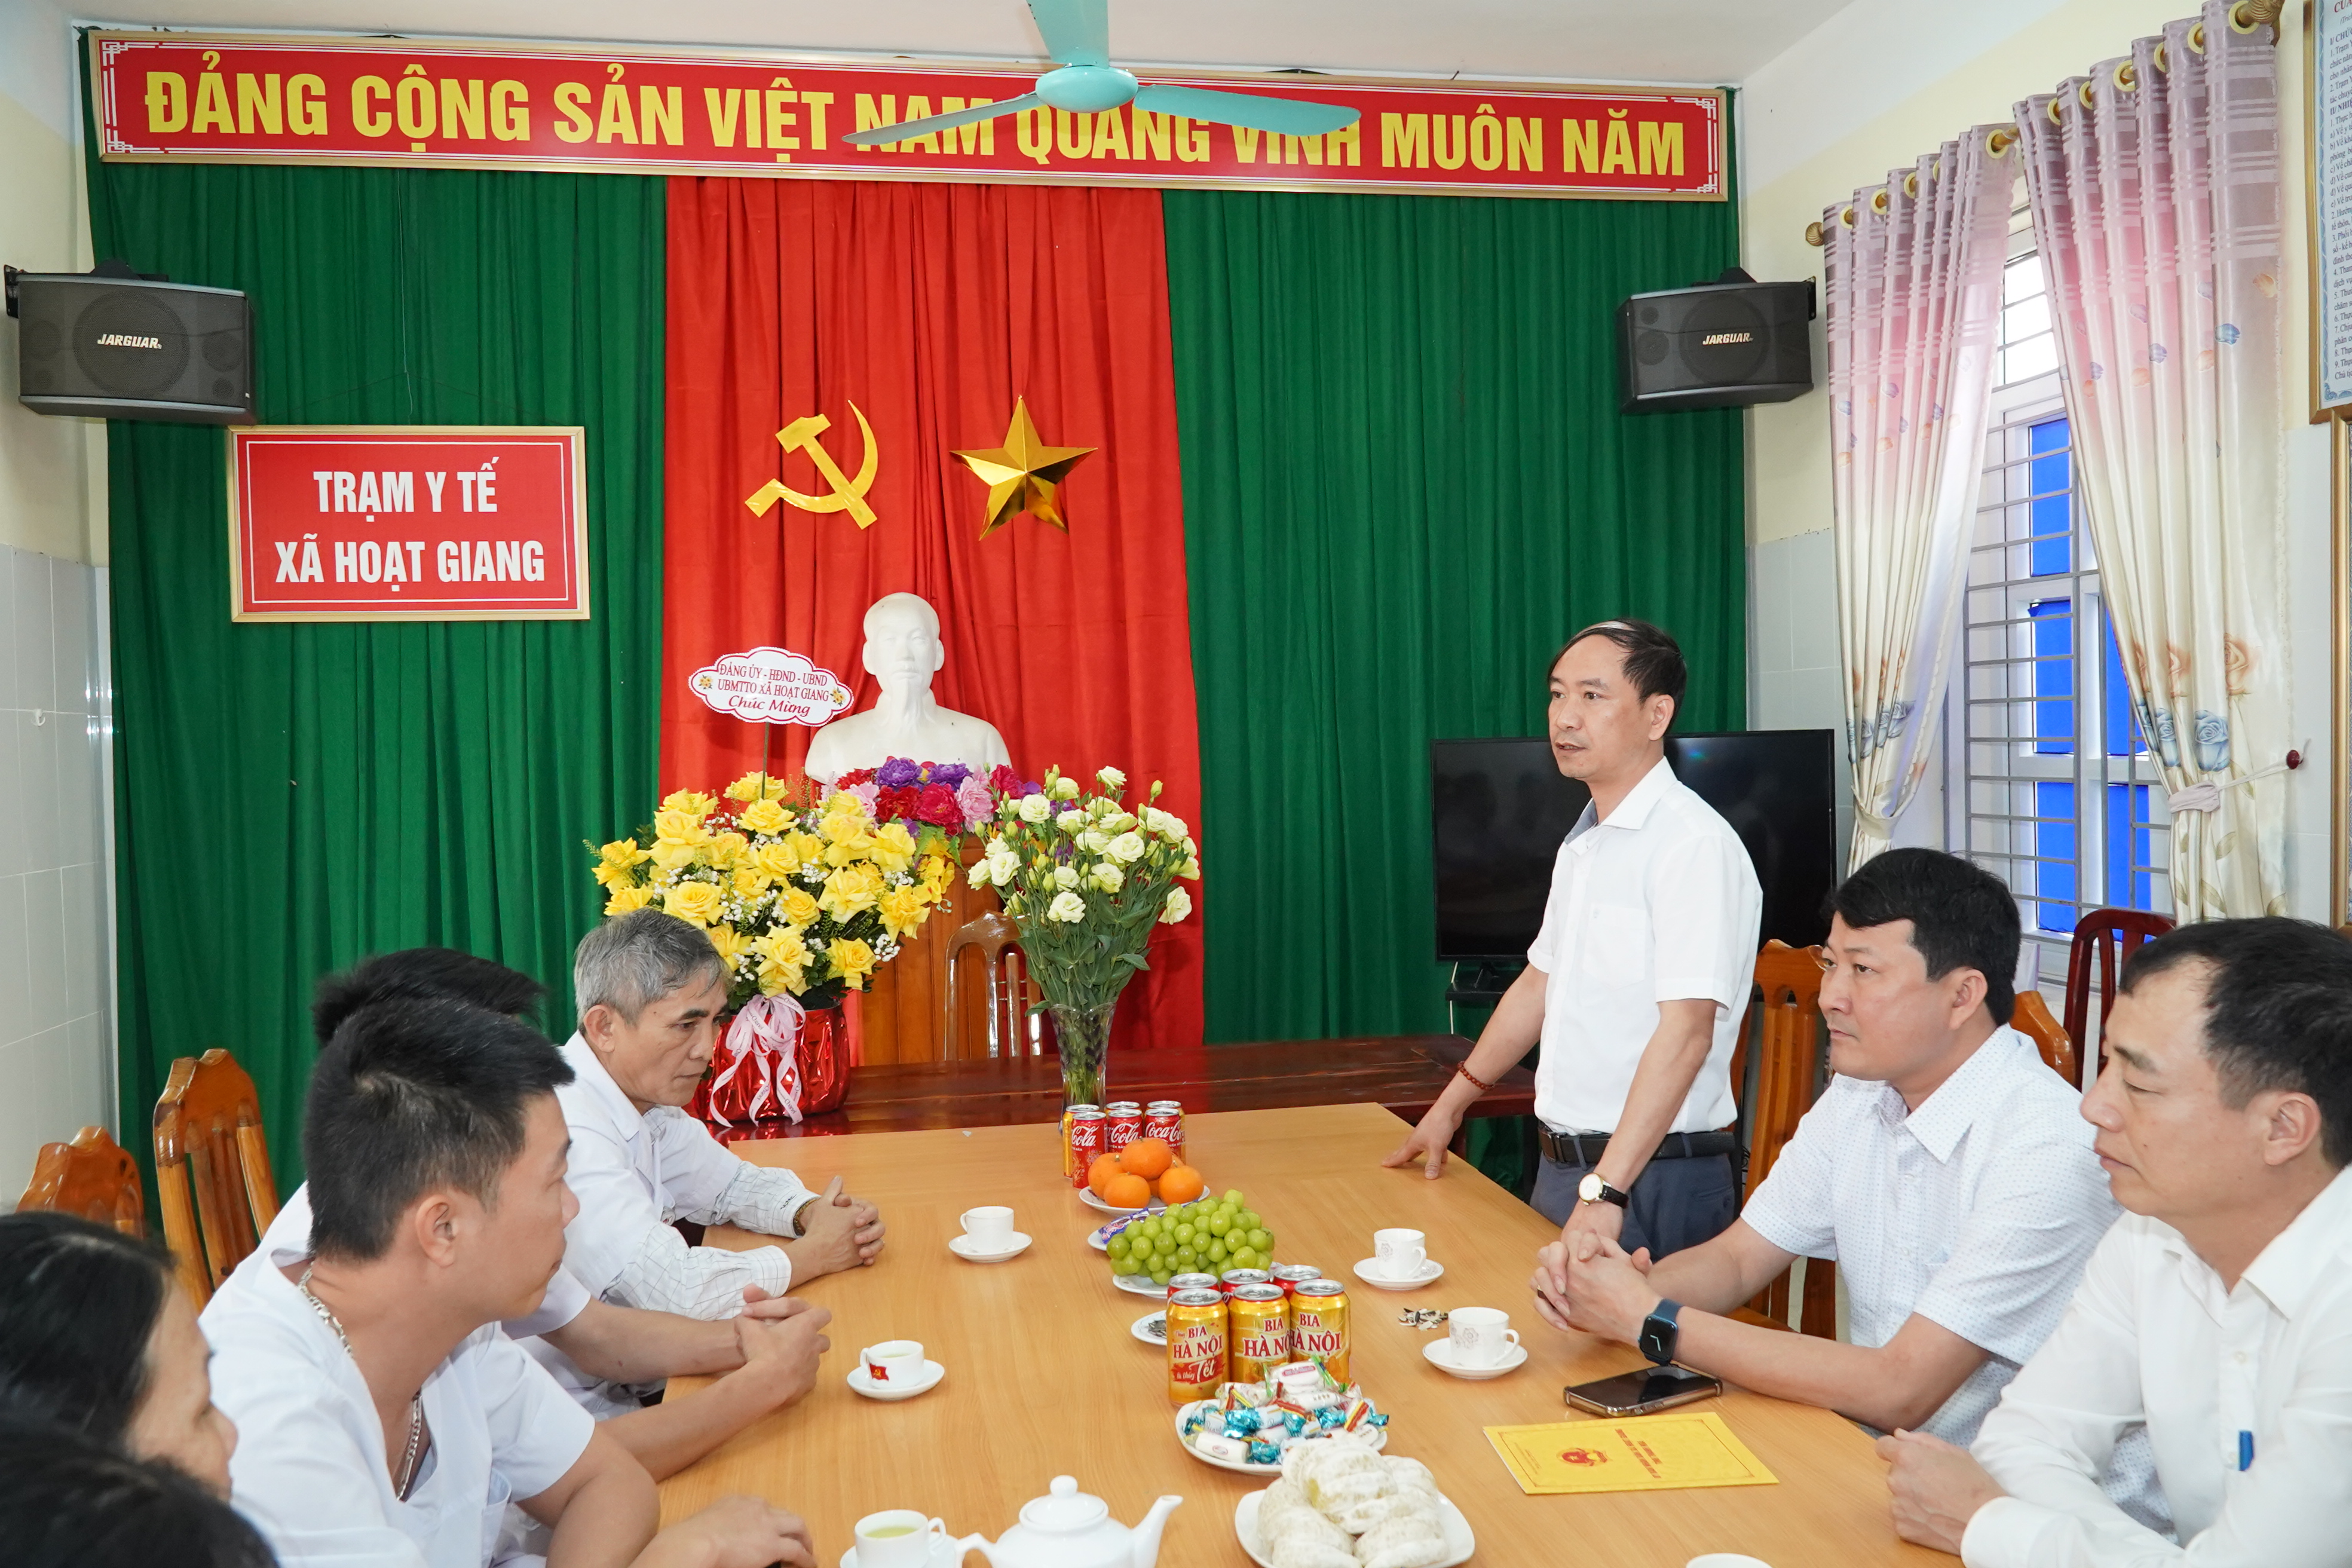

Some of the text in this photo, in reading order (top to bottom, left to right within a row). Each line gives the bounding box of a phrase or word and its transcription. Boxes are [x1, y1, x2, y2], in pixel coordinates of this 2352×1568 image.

[145, 51, 327, 136] ĐẢNG
[351, 65, 530, 152] CỘNG
[553, 63, 684, 146] SẢN
[705, 78, 834, 163] VIỆT
[855, 93, 994, 155] NAM
[1016, 108, 1210, 165] QUANG
[1382, 103, 1543, 172] MUÔN
[1563, 108, 1685, 176] NĂM
[313, 457, 500, 522] TRẠM Y TẾ
[275, 532, 545, 592] XÃ HOẠT GIANG
[719, 662, 746, 678] ĐẢNG
[768, 669, 796, 683] HĐND
[803, 673, 828, 687] UBND
[758, 681, 771, 696] XÃ
[774, 684, 800, 700] HOẠT
[801, 688, 829, 702] GIANG
[728, 695, 811, 717] Chúc Mừng
[1188, 1325, 1207, 1339] BIA
[1264, 1317, 1284, 1332] BIA
[1299, 1313, 1321, 1327] BIA
[1173, 1334, 1223, 1359] HÀ NỘI
[1244, 1334, 1272, 1356] HÀ
[1307, 1330, 1342, 1356] NỘI
[1188, 1358, 1215, 1383] Tết
